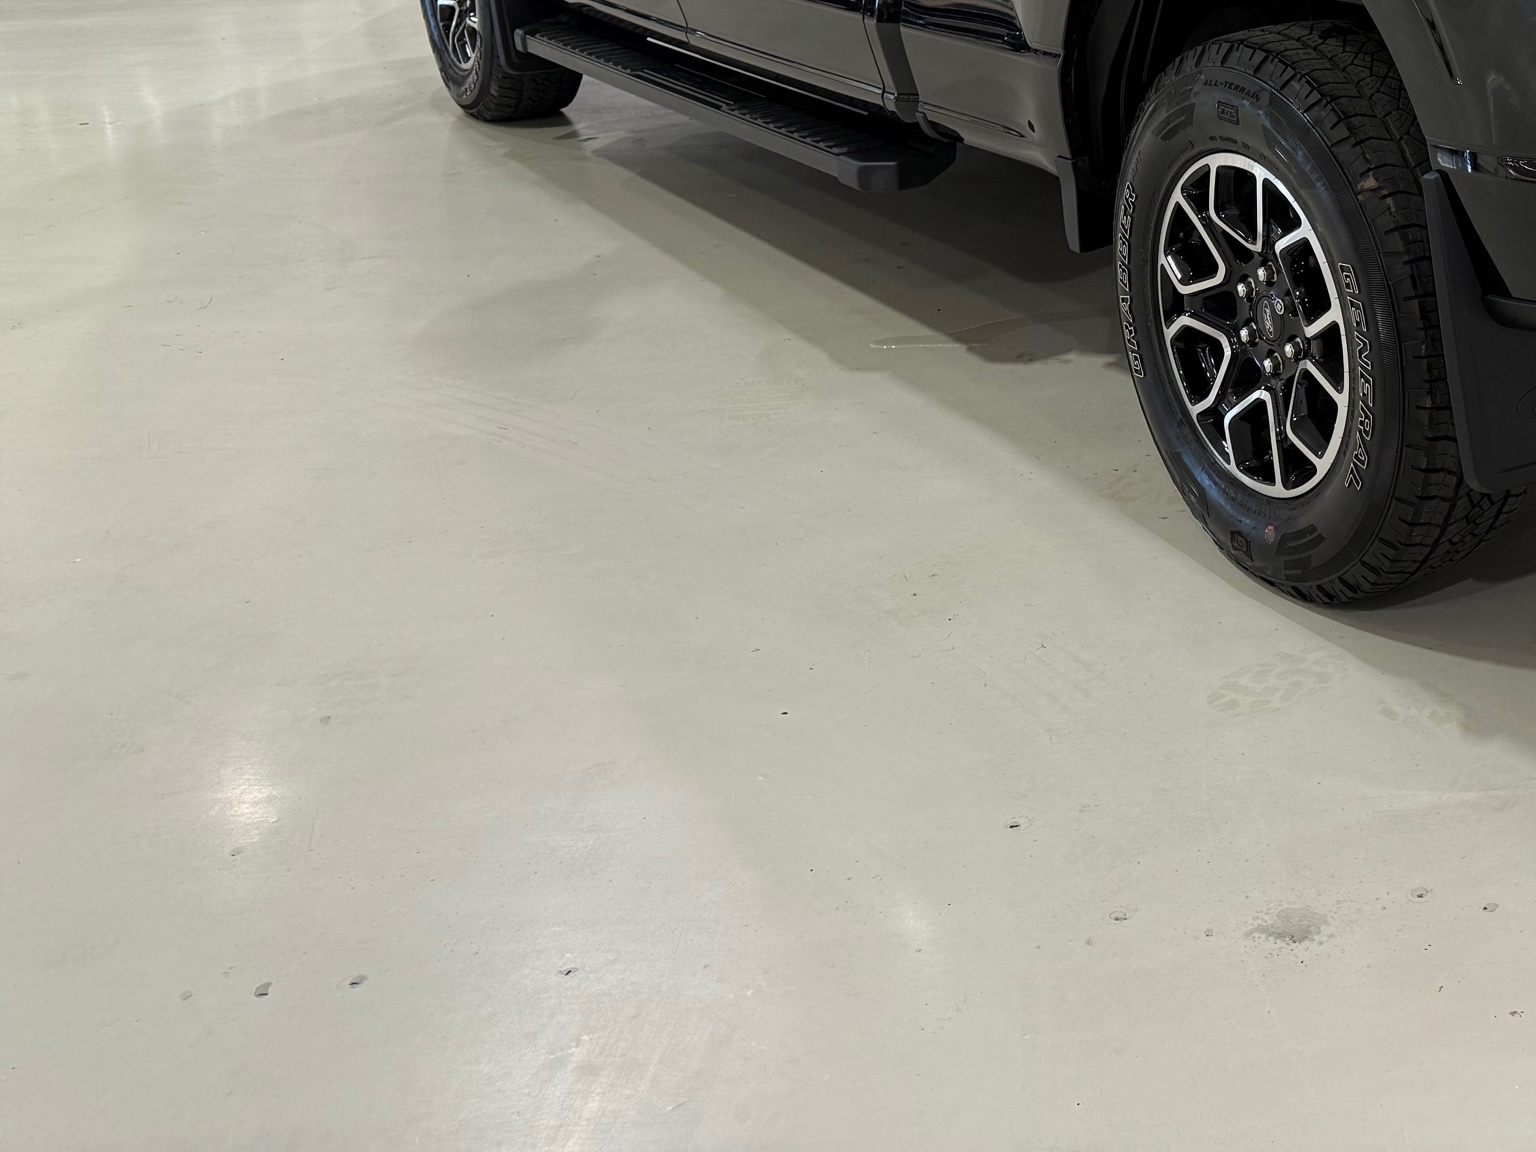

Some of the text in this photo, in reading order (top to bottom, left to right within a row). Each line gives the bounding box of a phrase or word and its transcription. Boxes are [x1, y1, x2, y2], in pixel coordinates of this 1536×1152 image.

[1202, 79, 1262, 103] ALL-TERRAIN
[1117, 181, 1145, 378] GRABBER
[1338, 262, 1374, 491] GENERAL
